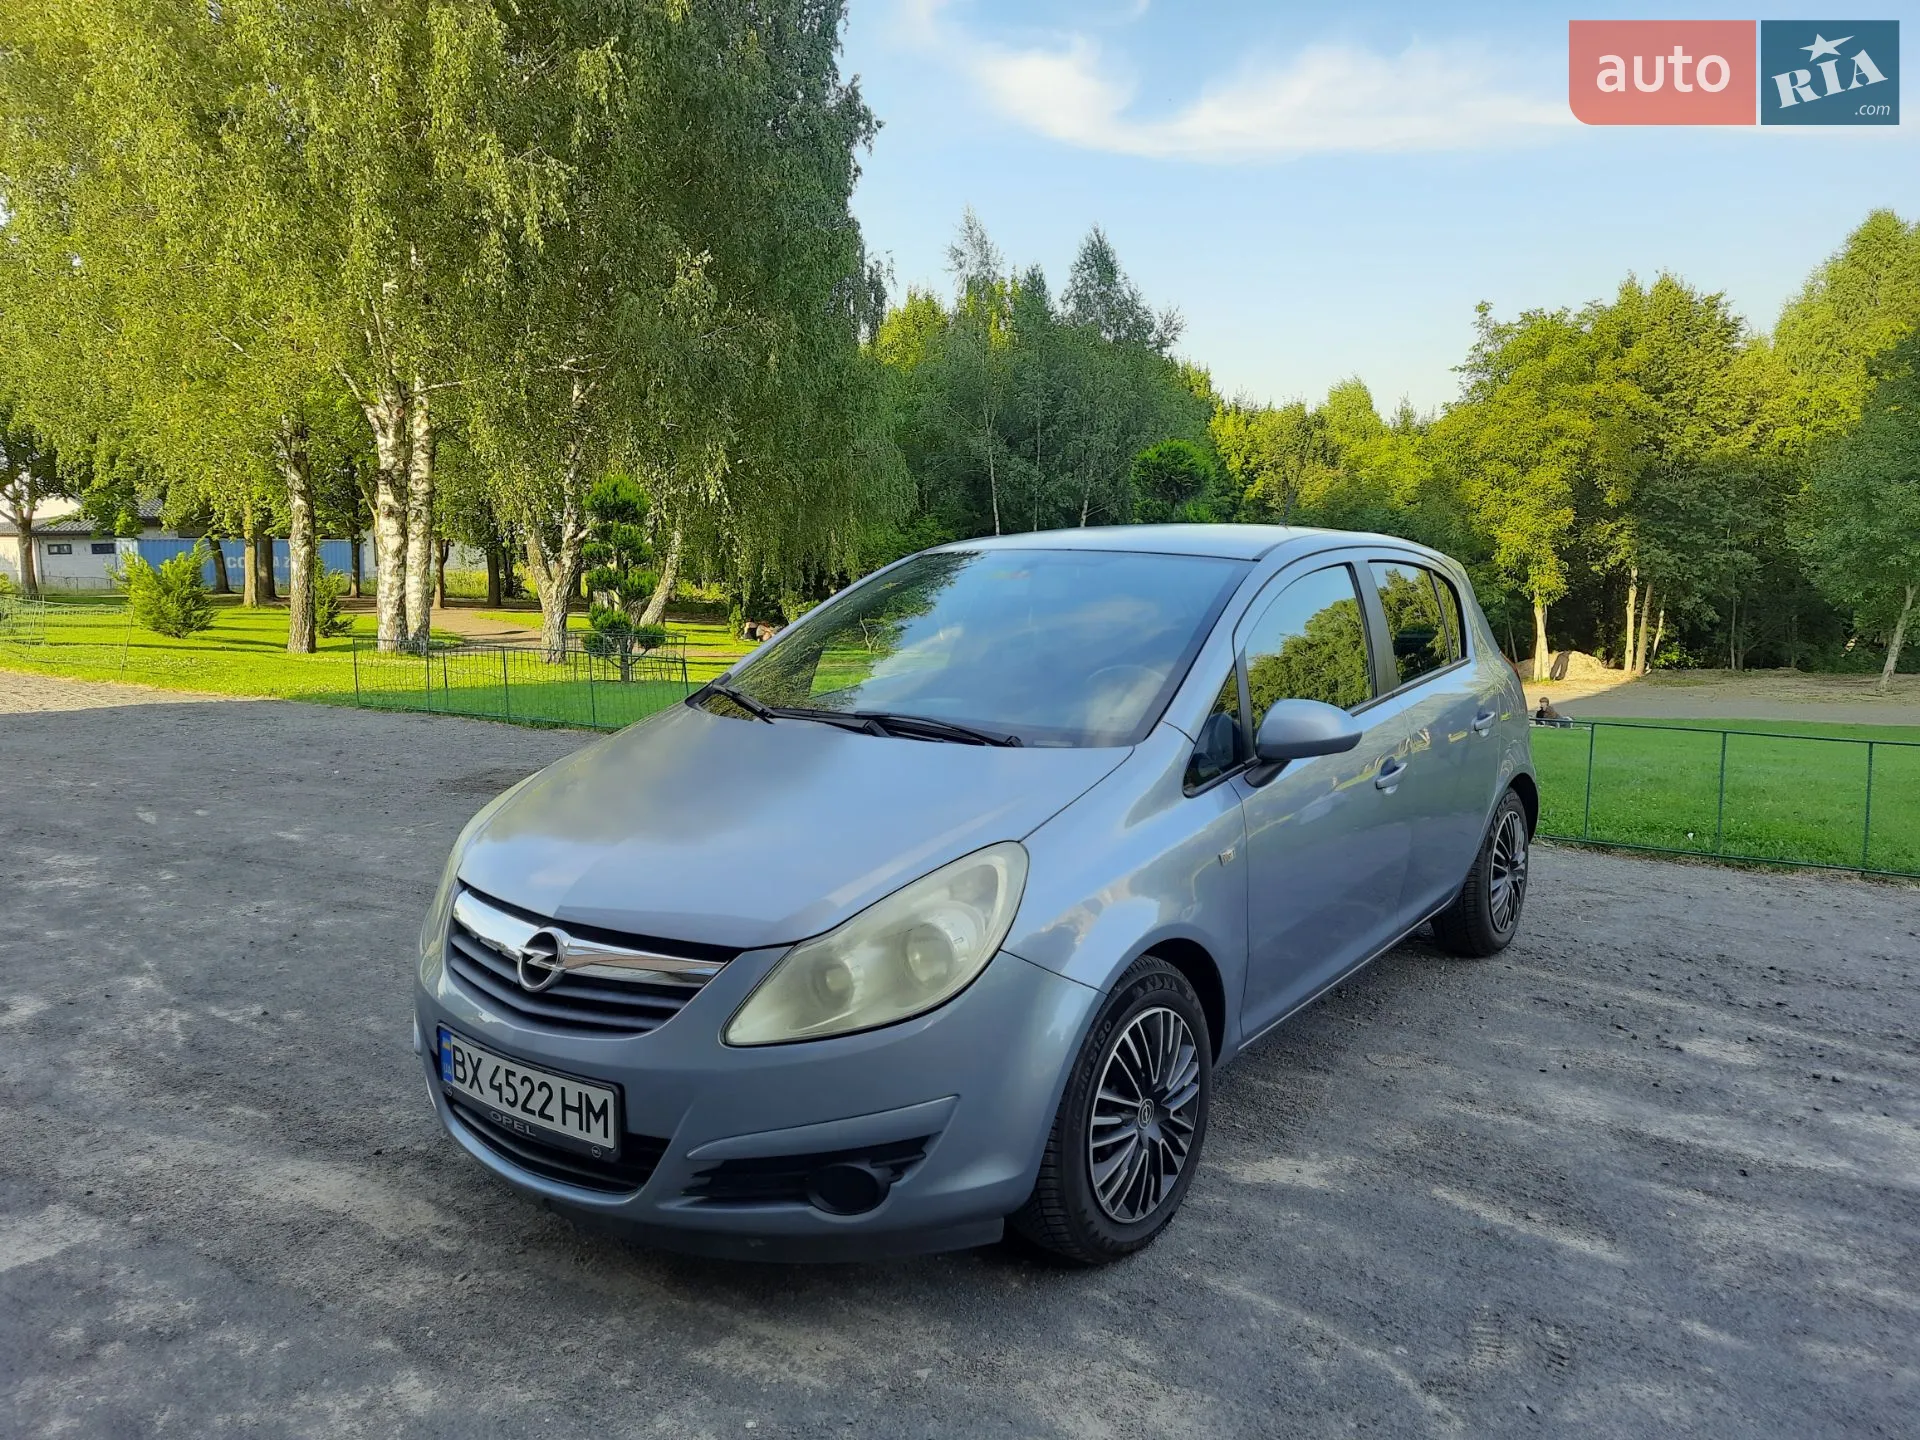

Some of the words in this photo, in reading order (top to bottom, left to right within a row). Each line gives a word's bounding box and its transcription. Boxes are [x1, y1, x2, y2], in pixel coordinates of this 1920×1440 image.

[452, 1044, 484, 1095] BX
[489, 1065, 555, 1122] 4522
[561, 1086, 609, 1139] HM
[489, 1110, 537, 1137] OPEL
